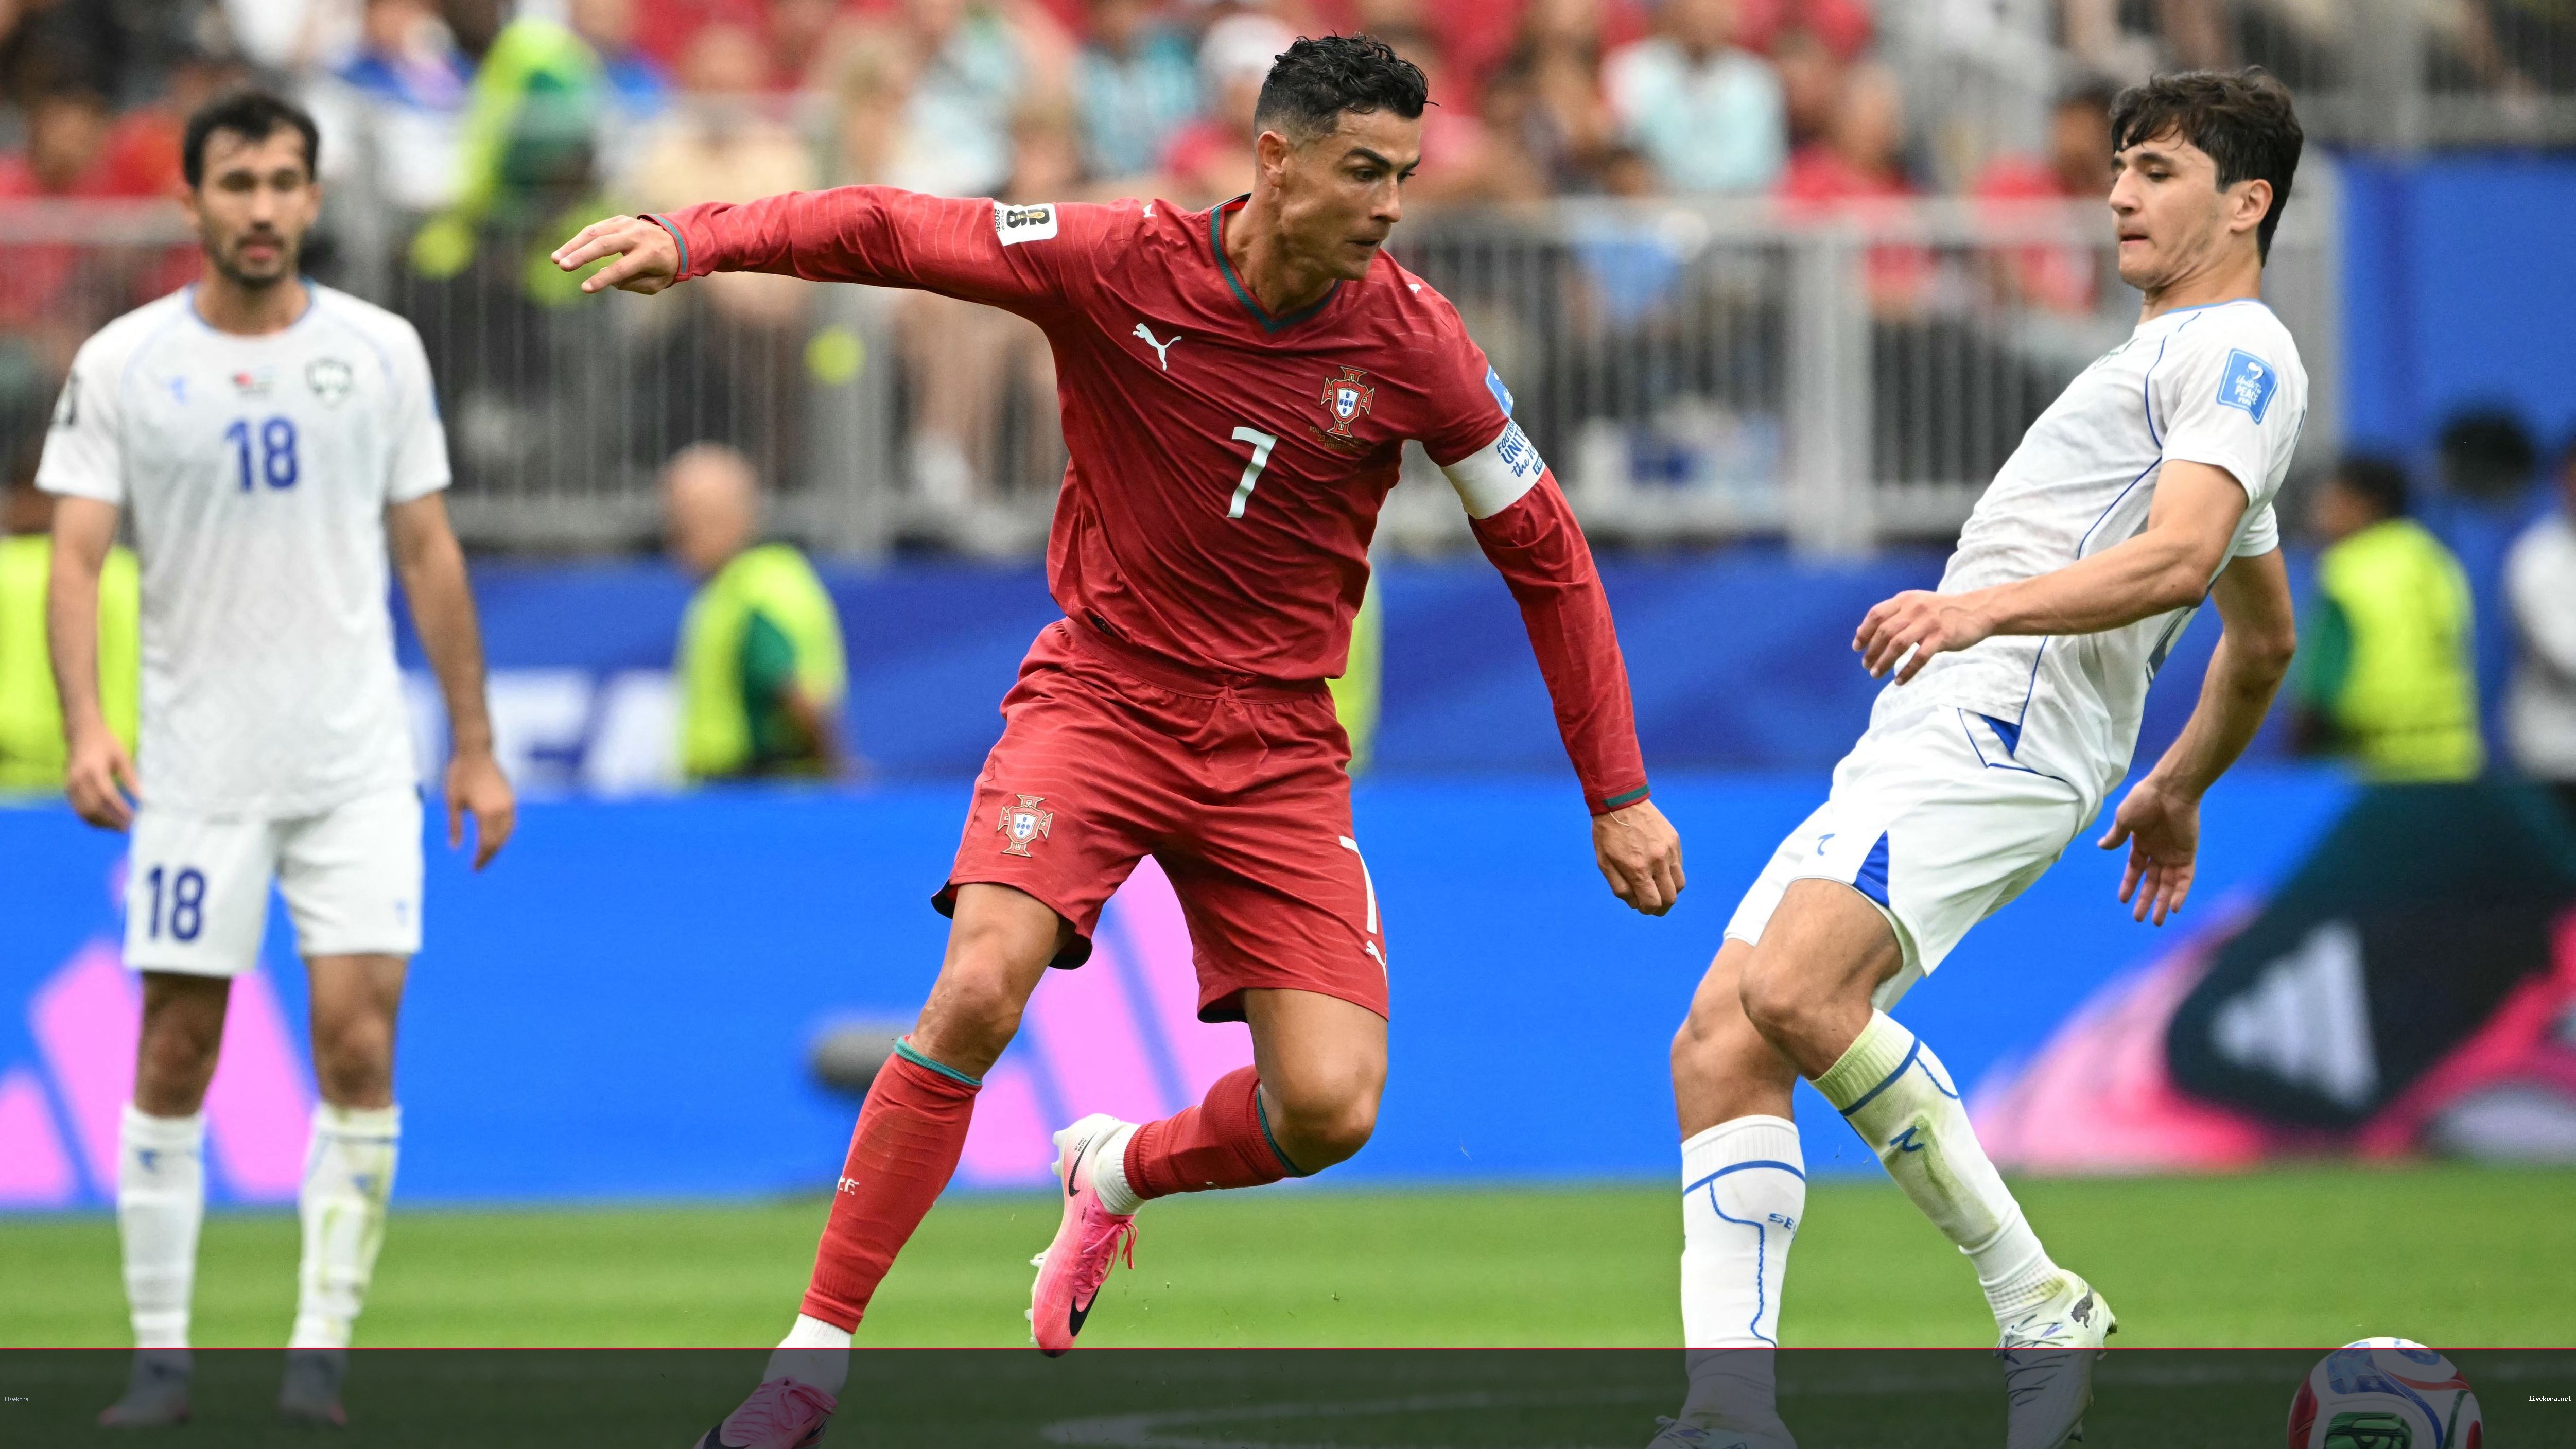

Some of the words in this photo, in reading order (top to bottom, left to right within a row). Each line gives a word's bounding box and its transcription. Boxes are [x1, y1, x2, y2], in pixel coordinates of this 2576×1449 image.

[2235, 385, 2259, 405] PEACE
[225, 416, 299, 492] 18
[1226, 426, 1279, 518] 7
[1496, 420, 1515, 453] FOOTBA
[1511, 458, 1529, 477] the
[147, 867, 206, 942] 18
[1338, 835, 1377, 934] 7
